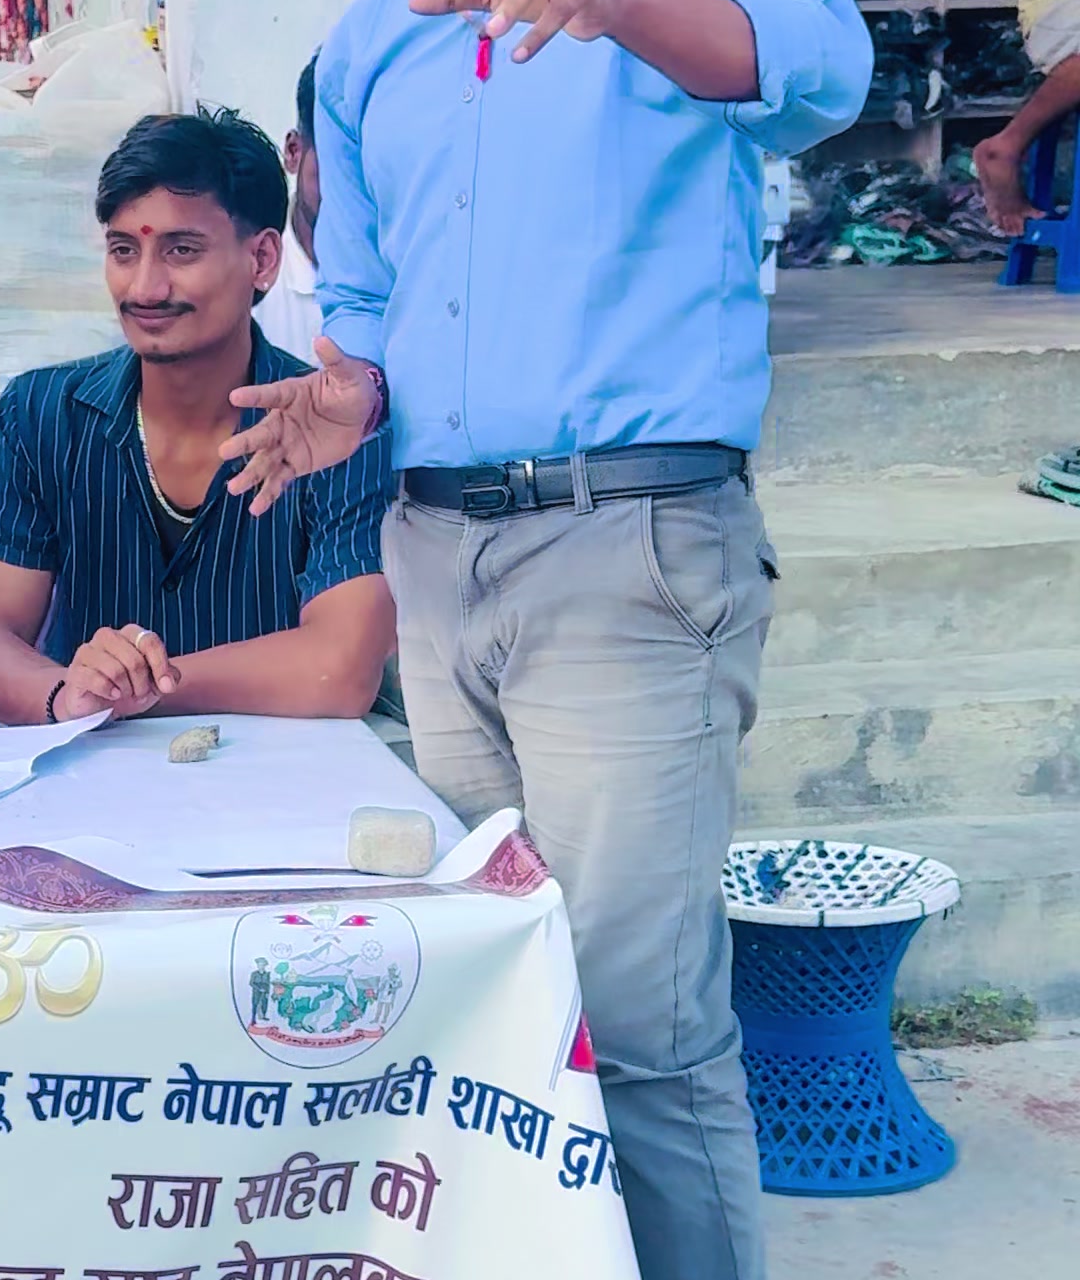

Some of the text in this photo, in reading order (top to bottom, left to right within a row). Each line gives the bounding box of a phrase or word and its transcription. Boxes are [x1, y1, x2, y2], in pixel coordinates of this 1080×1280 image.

[26, 1073, 151, 1126] सम्राट
[163, 1063, 292, 1129] नेपाल
[448, 1076, 554, 1160] शाखा
[108, 1152, 441, 1231] राजा सहित को
